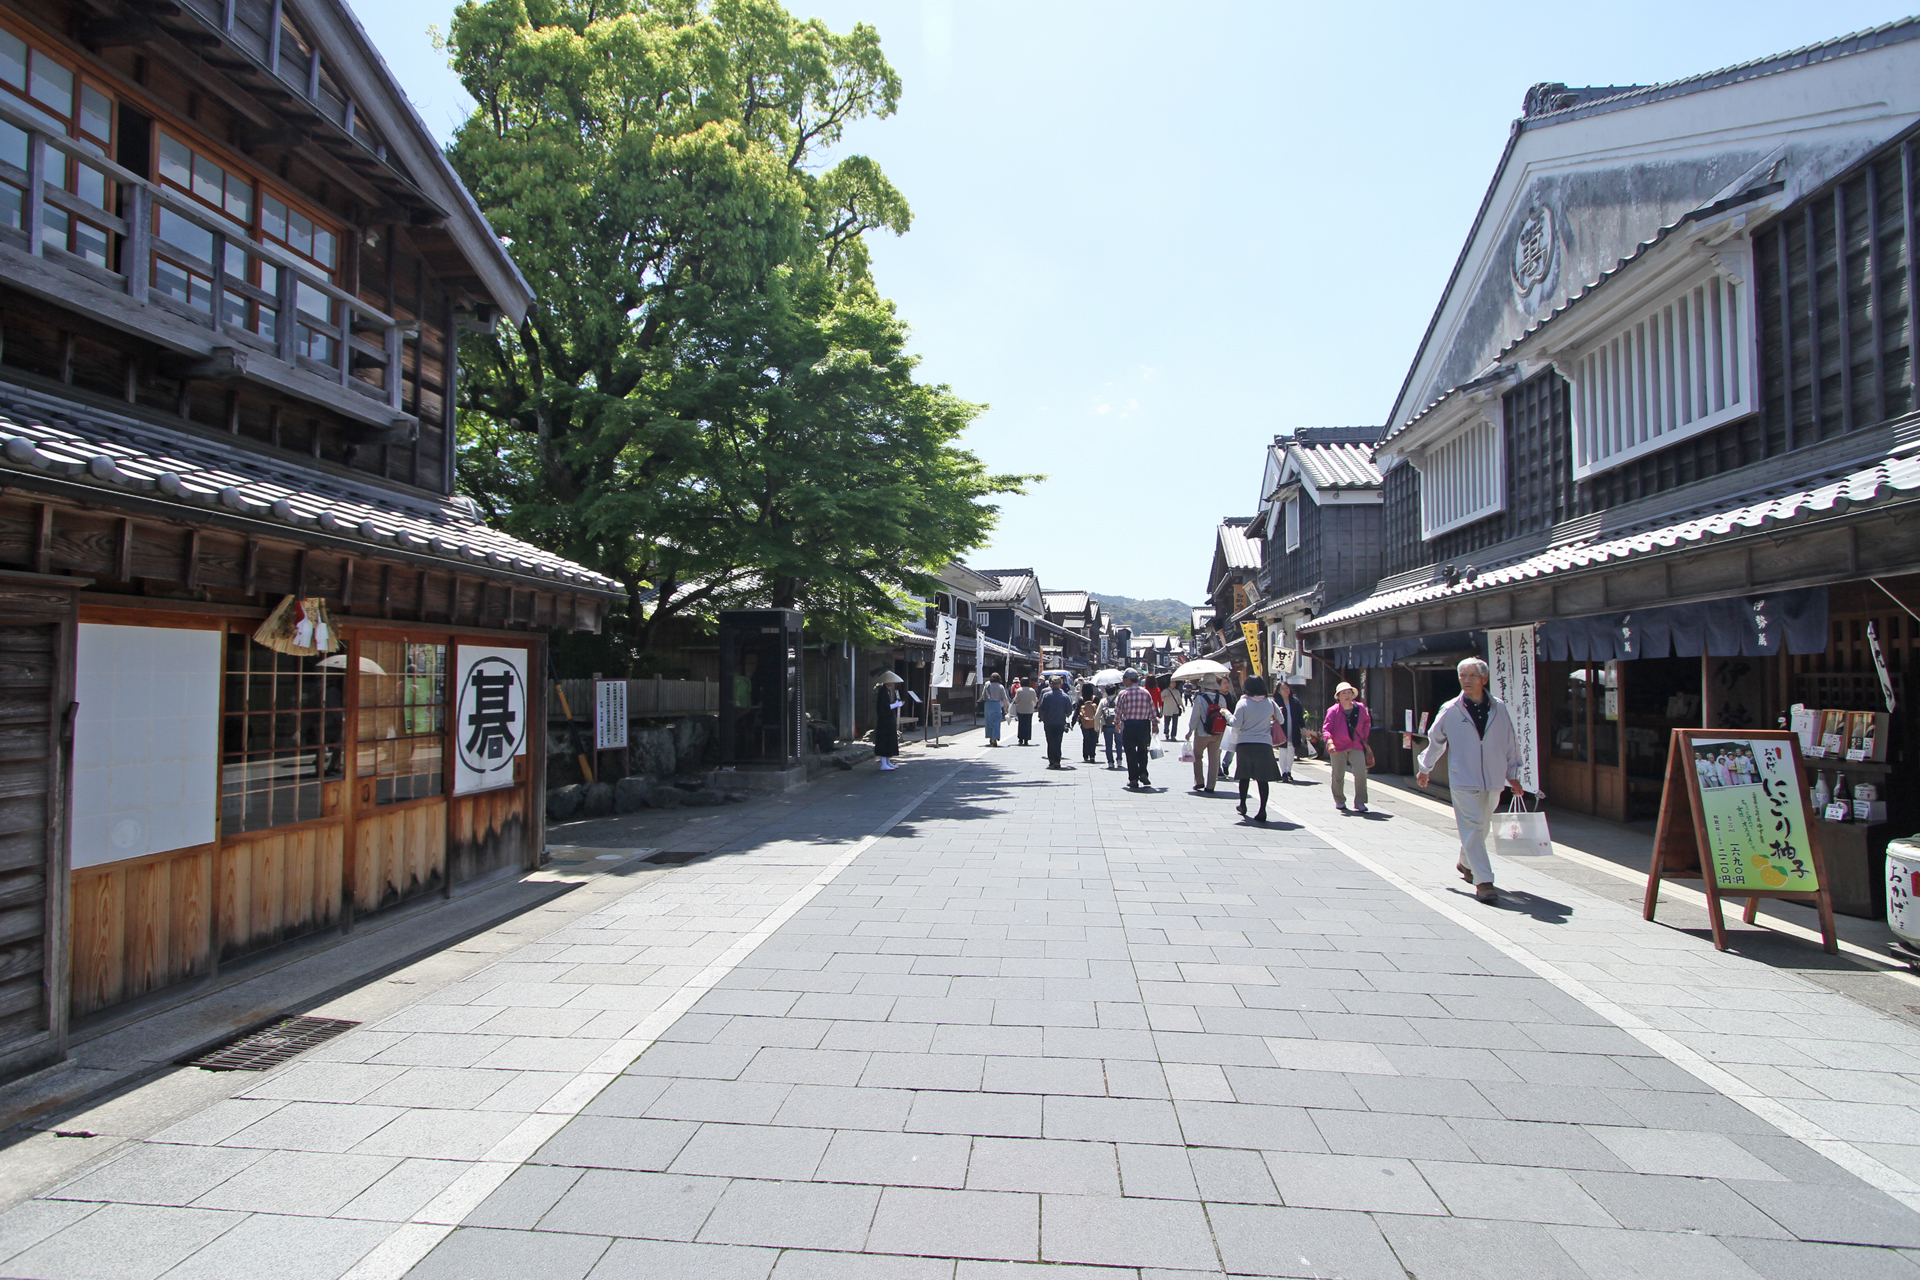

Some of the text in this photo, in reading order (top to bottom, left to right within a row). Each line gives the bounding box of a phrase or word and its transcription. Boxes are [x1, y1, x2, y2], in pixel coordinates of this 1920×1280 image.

[1275, 650, 1287, 670] 甘酒
[465, 669, 516, 760] 碁
[1763, 778, 1811, 879] にごり柚子
